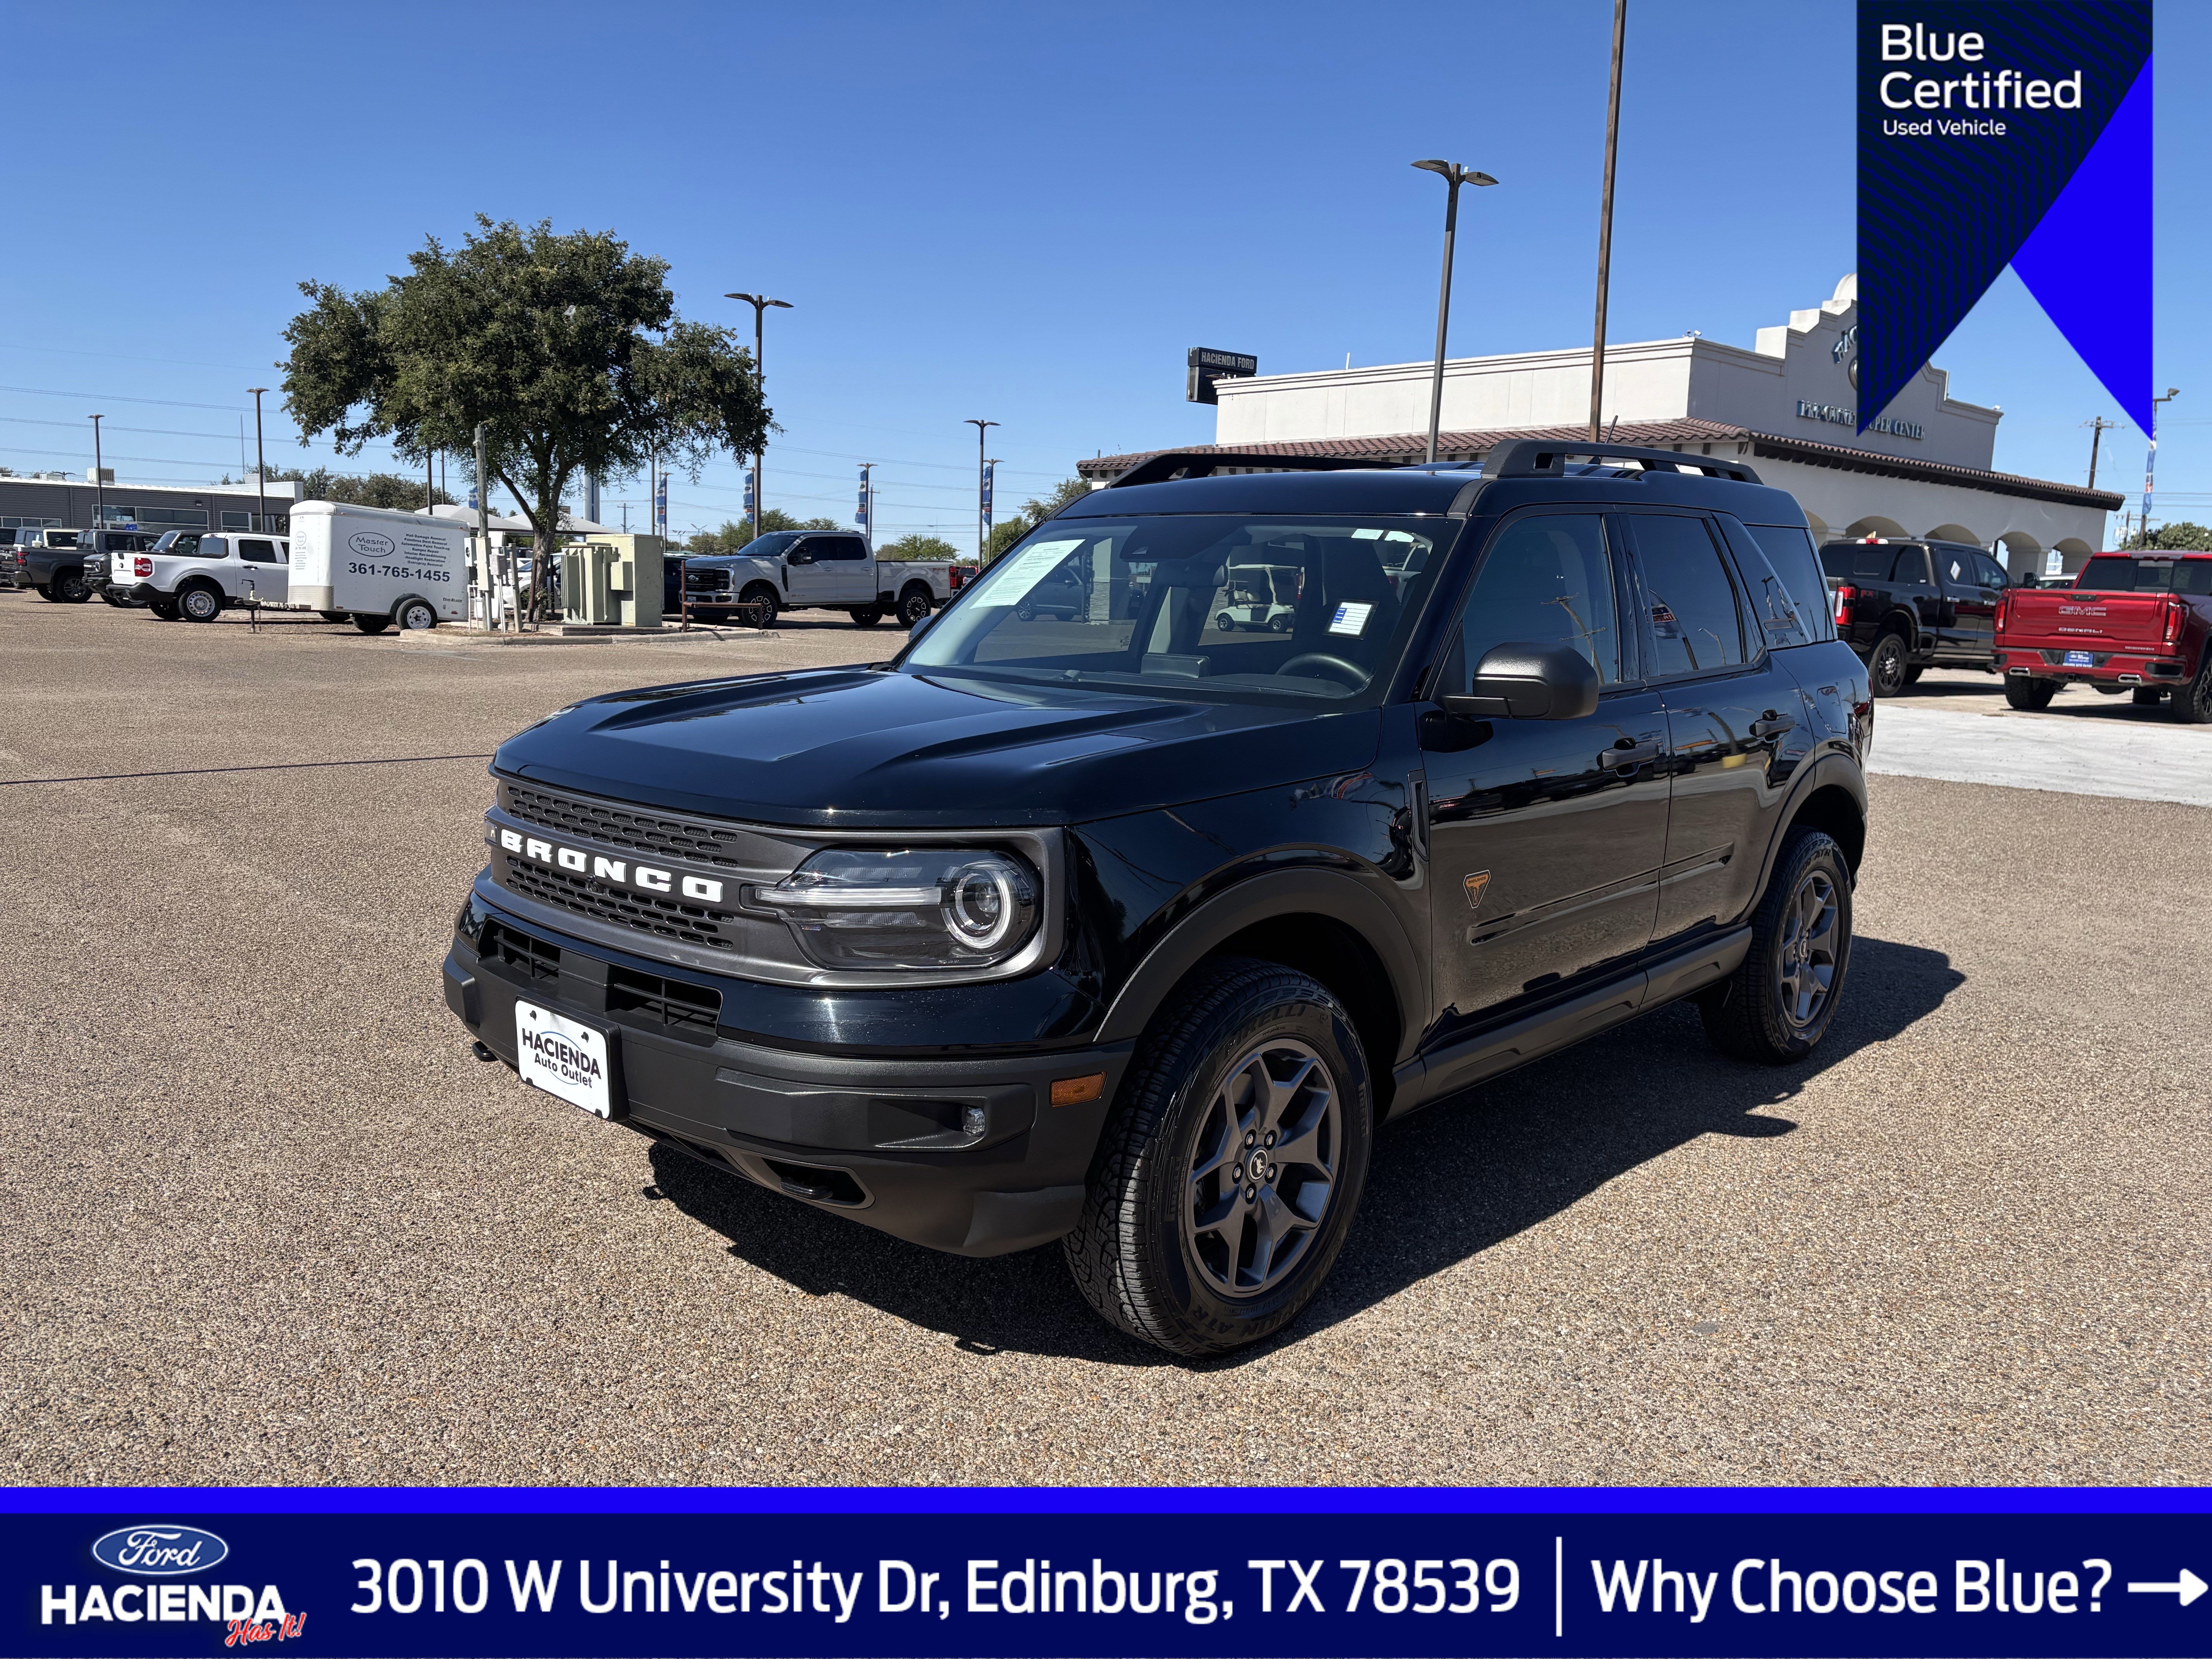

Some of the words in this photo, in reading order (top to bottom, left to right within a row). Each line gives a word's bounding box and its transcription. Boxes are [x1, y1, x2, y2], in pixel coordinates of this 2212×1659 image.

[1202, 351, 1236, 367] HACIENDA
[1237, 357, 1255, 370] FORD
[1865, 416, 1892, 433] UPER
[1894, 420, 1926, 440] CENTER
[356, 536, 388, 546] Master
[358, 544, 386, 553] Touch
[348, 562, 450, 582] 361-765-1455
[2058, 605, 2107, 617] GMC
[500, 828, 724, 903] BRONCO
[1223, 1004, 1307, 1060] PIRELLI
[522, 1027, 602, 1080] HACIENDA
[534, 1053, 558, 1072] Auto
[561, 1064, 592, 1089] Outlet
[1191, 1304, 1234, 1334] ATR
